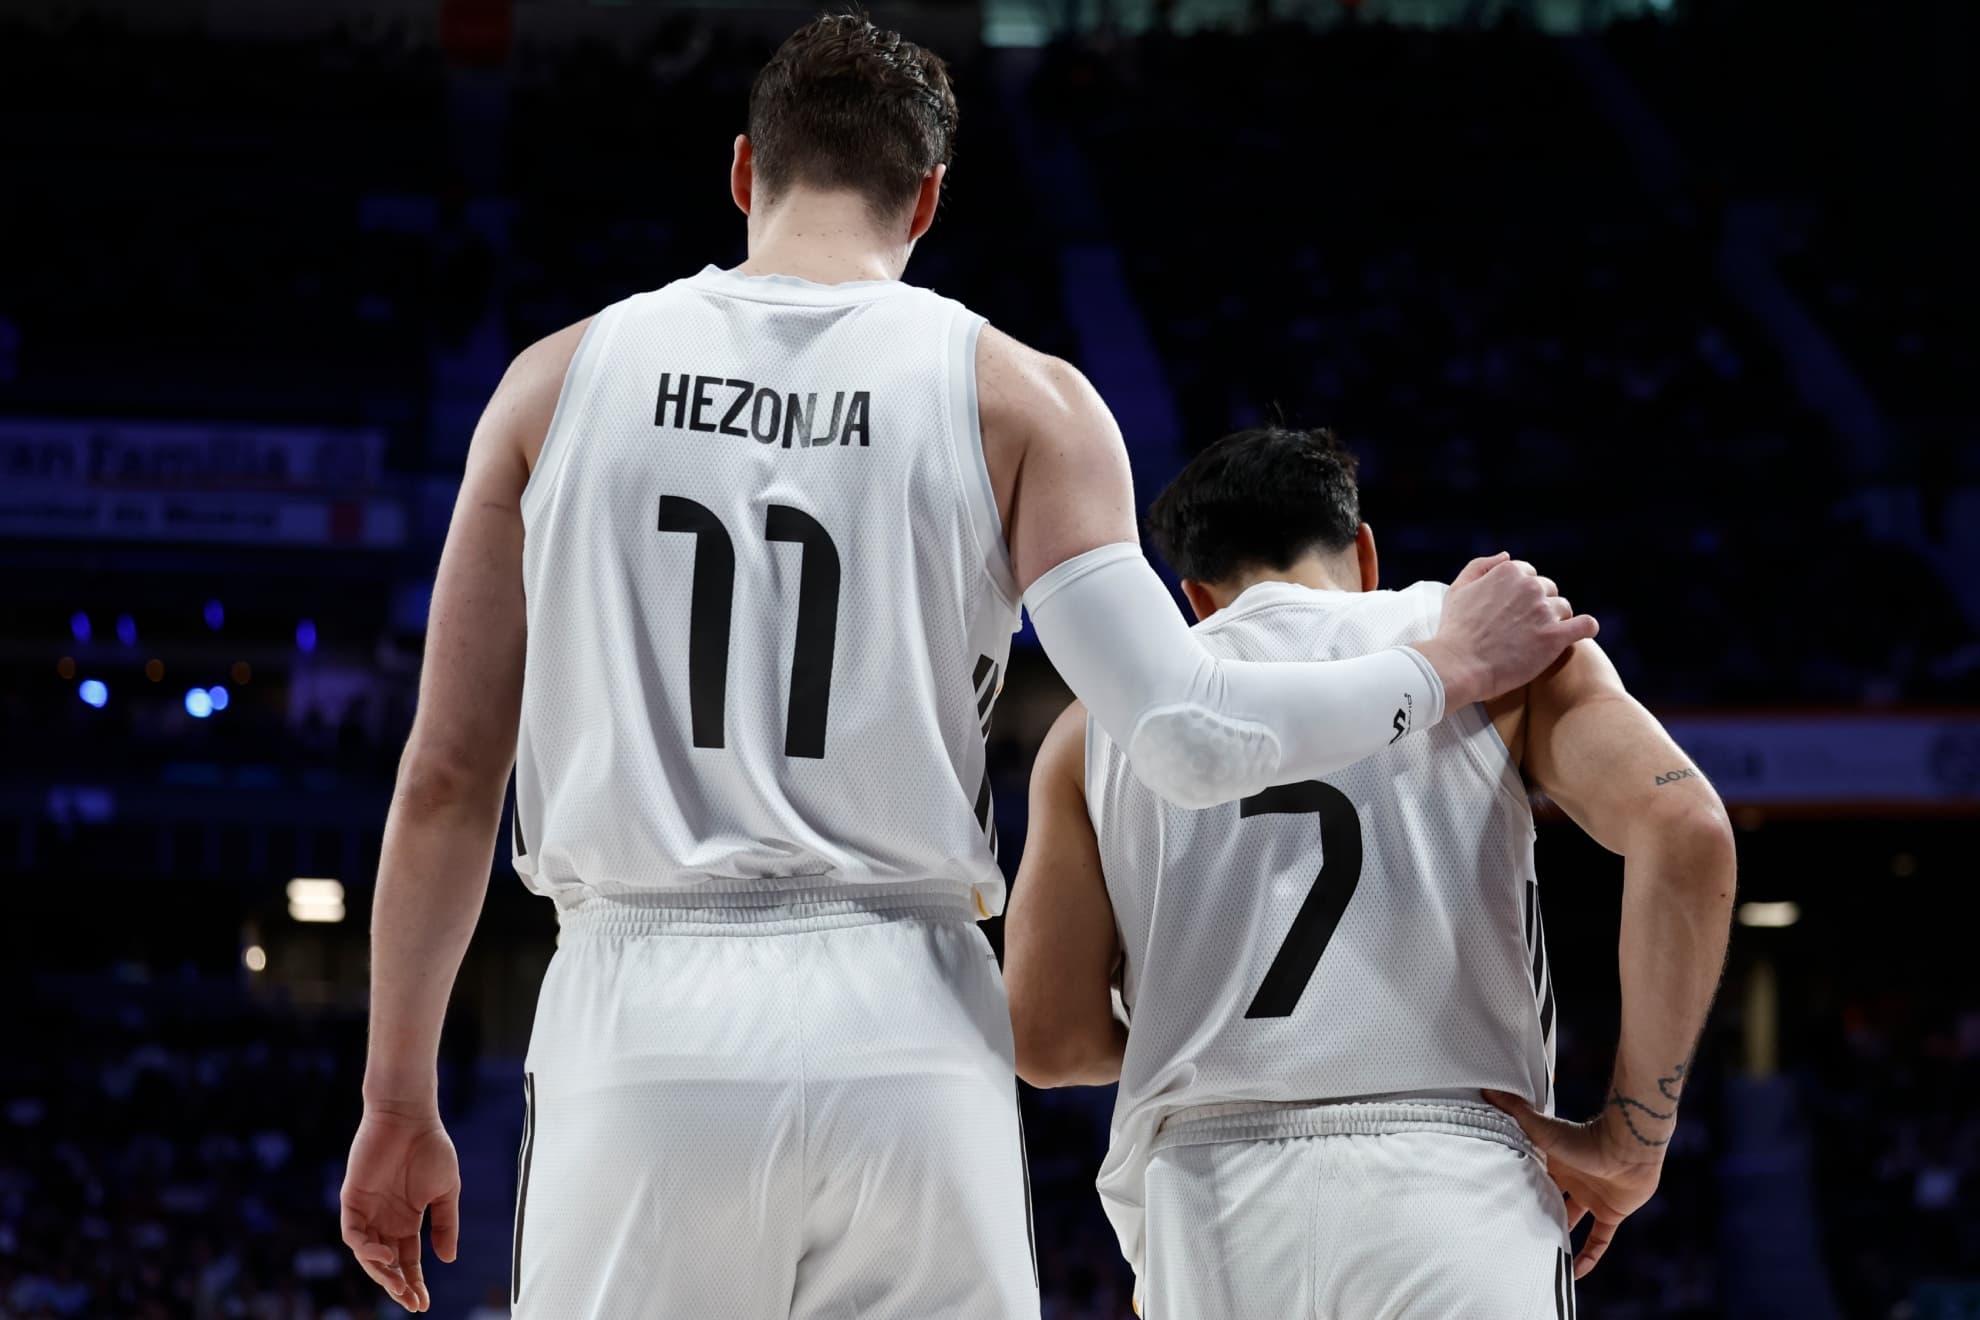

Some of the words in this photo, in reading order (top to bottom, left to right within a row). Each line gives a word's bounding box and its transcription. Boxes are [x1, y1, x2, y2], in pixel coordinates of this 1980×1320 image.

[654, 373, 870, 449] HEZONJA
[657, 494, 841, 760] 11
[1239, 779, 1363, 1019] 7
